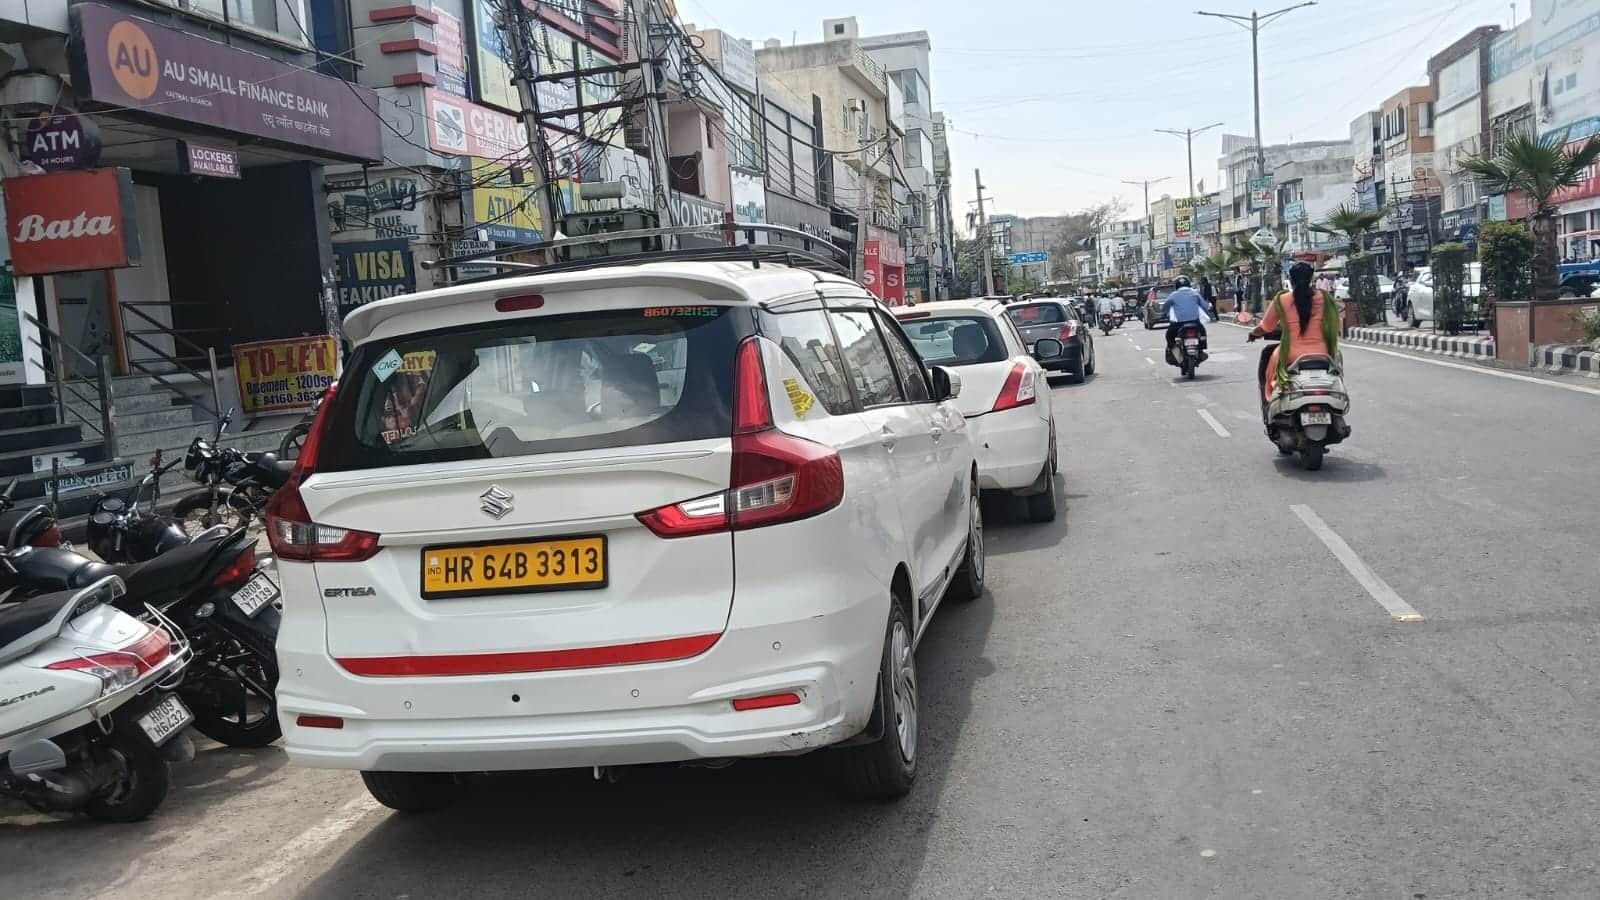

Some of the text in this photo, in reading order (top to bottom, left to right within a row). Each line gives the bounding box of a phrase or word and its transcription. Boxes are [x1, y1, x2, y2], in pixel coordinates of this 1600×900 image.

[115, 41, 150, 77] AU
[163, 59, 329, 119] AU SMALL FINANCE BANK
[33, 129, 80, 153] ATM
[191, 148, 233, 164] LOCKERS
[193, 160, 236, 175] AVAILABLE
[375, 216, 402, 227] BLUE
[487, 195, 514, 224] ATM
[15, 210, 115, 242] Bata
[354, 250, 405, 280] VISA
[242, 342, 328, 378] TO-LET
[428, 547, 599, 583] IND HR 64B 3313
